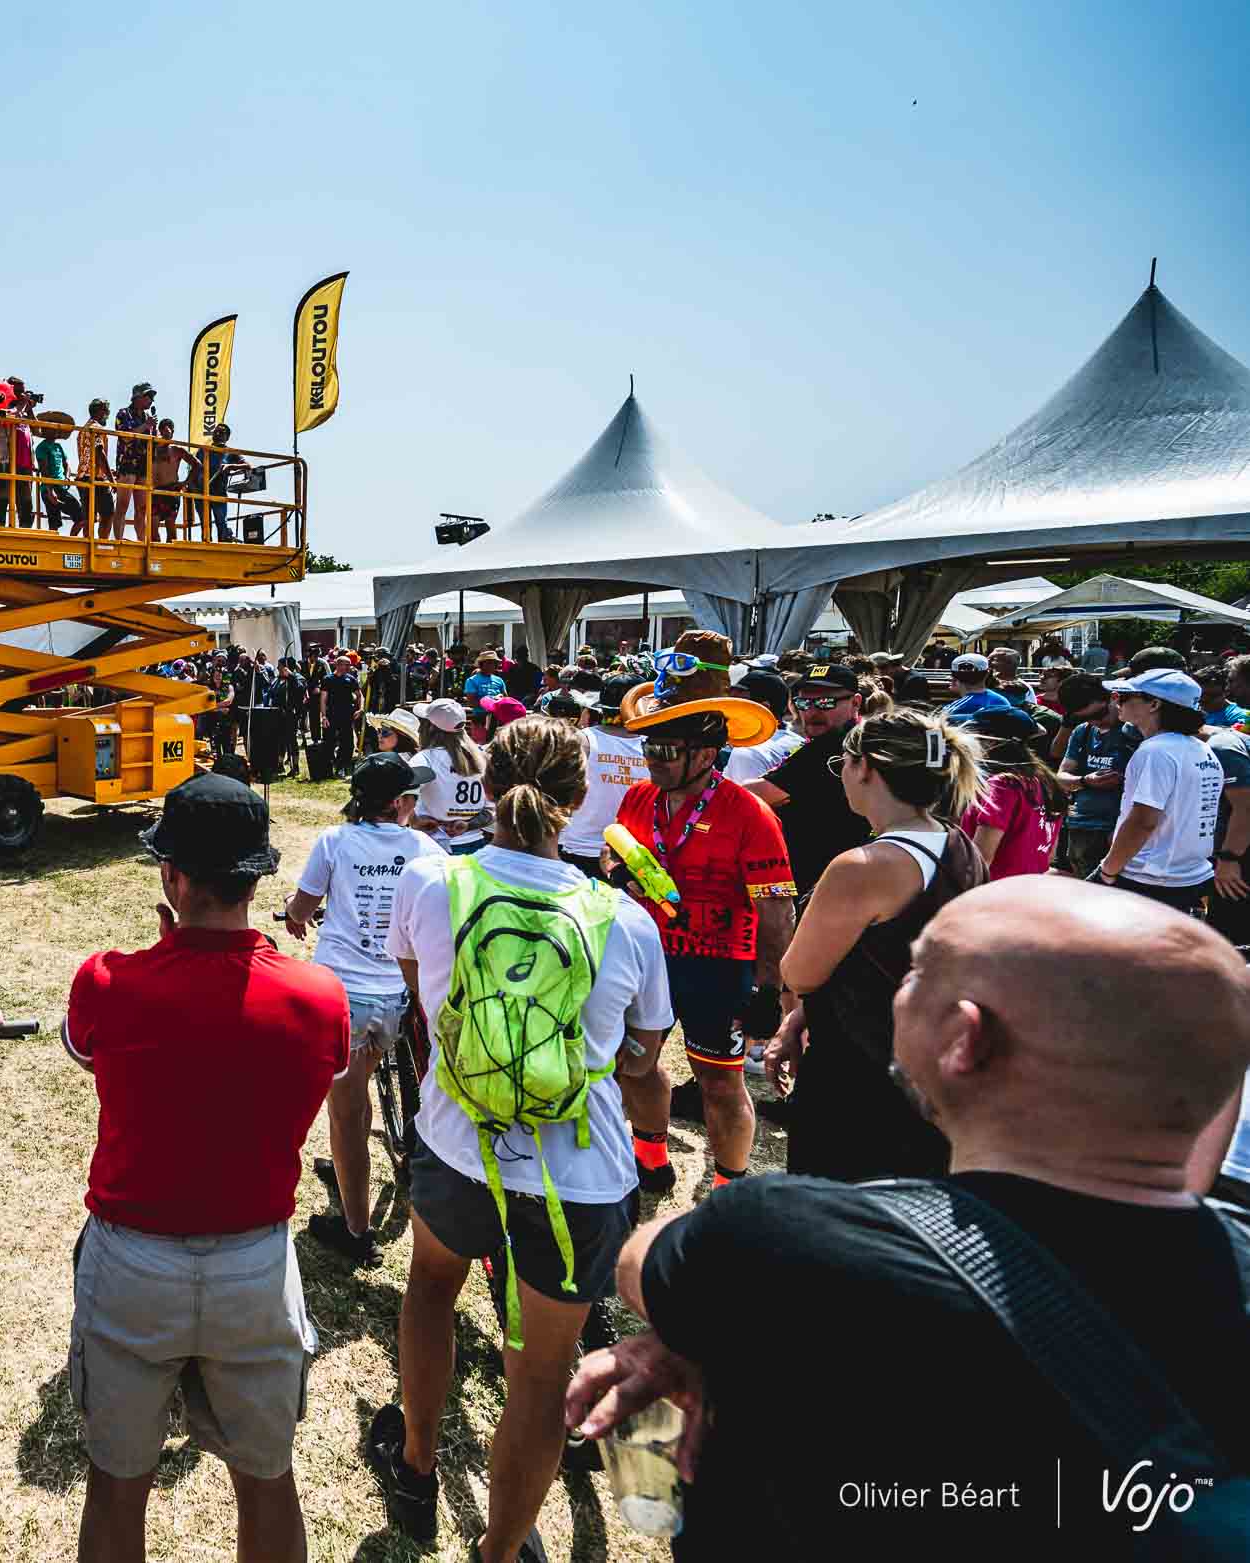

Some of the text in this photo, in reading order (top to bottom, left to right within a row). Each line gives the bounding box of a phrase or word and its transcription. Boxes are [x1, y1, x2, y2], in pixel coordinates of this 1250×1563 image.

[455, 781, 482, 805] 80
[359, 864, 403, 877] CRAPAU
[748, 858, 788, 872] ESPA
